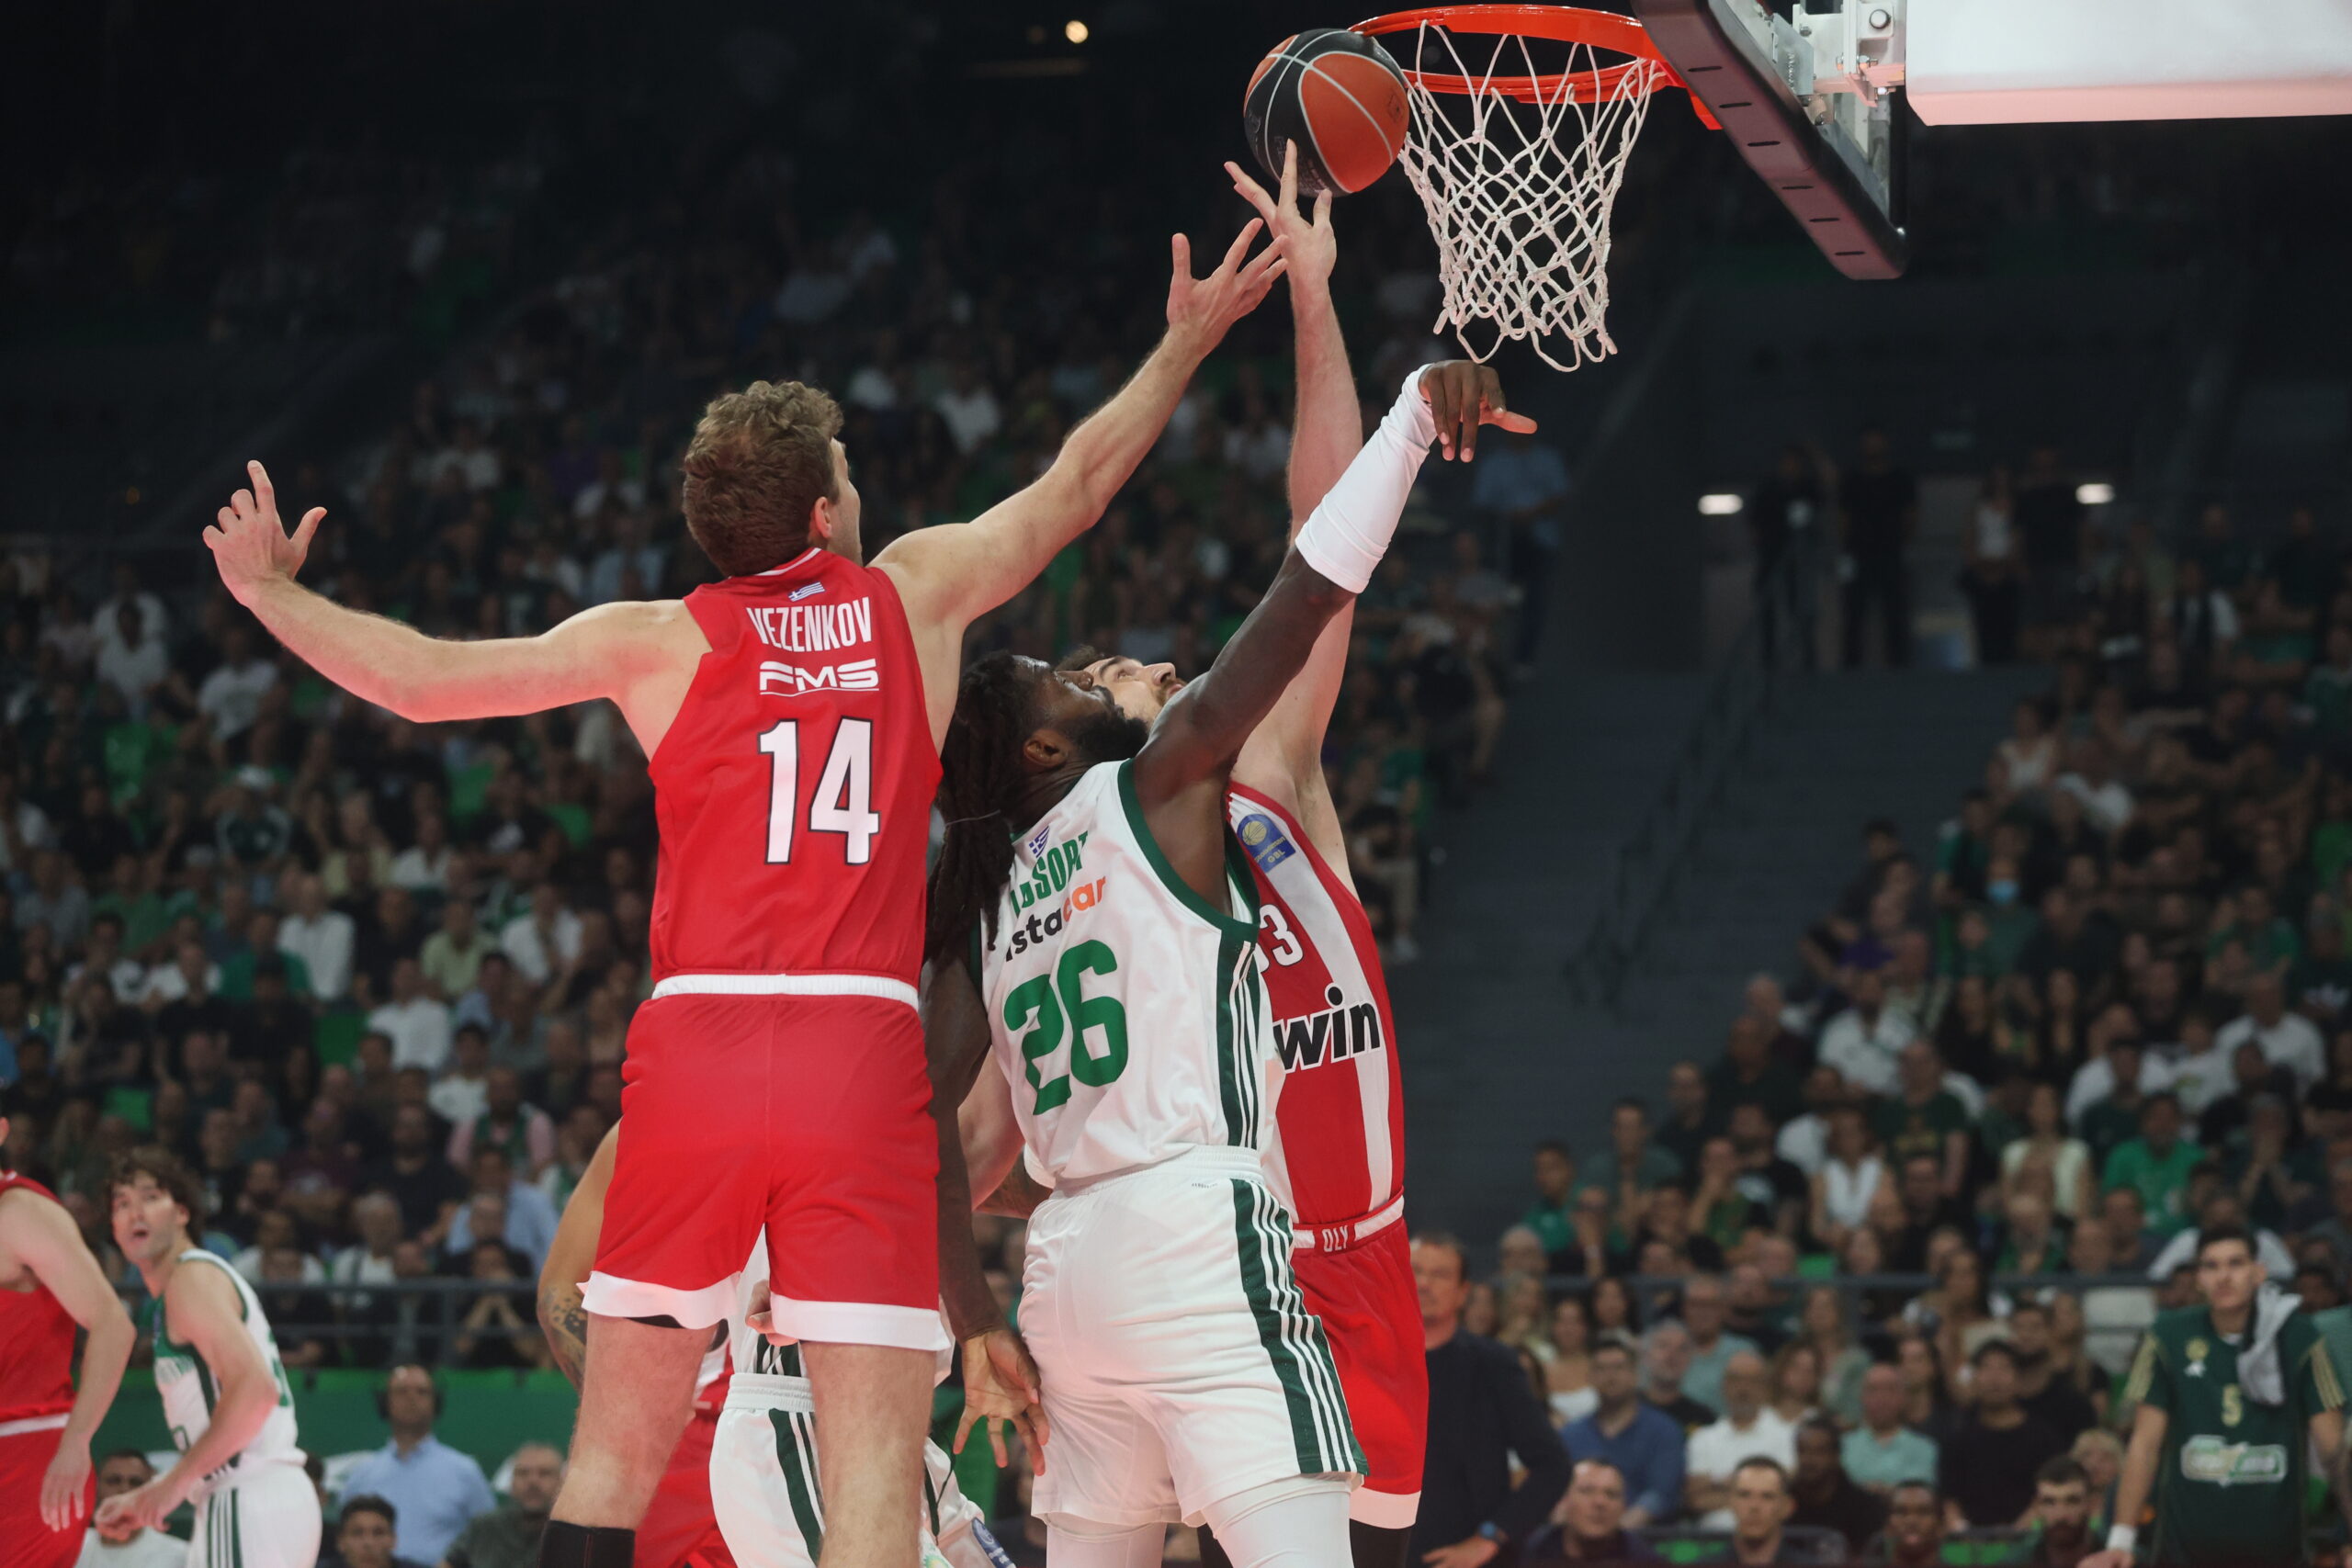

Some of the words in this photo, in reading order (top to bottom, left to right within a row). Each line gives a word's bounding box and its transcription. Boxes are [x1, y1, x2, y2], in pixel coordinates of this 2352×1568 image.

[746, 597, 872, 653] VEZENKOV
[759, 658, 880, 693] FMS
[757, 715, 881, 865] 14
[1005, 875, 1106, 962] stacar
[1003, 939, 1129, 1116] 26
[1272, 984, 1382, 1073] win
[2221, 1383, 2244, 1427] 5
